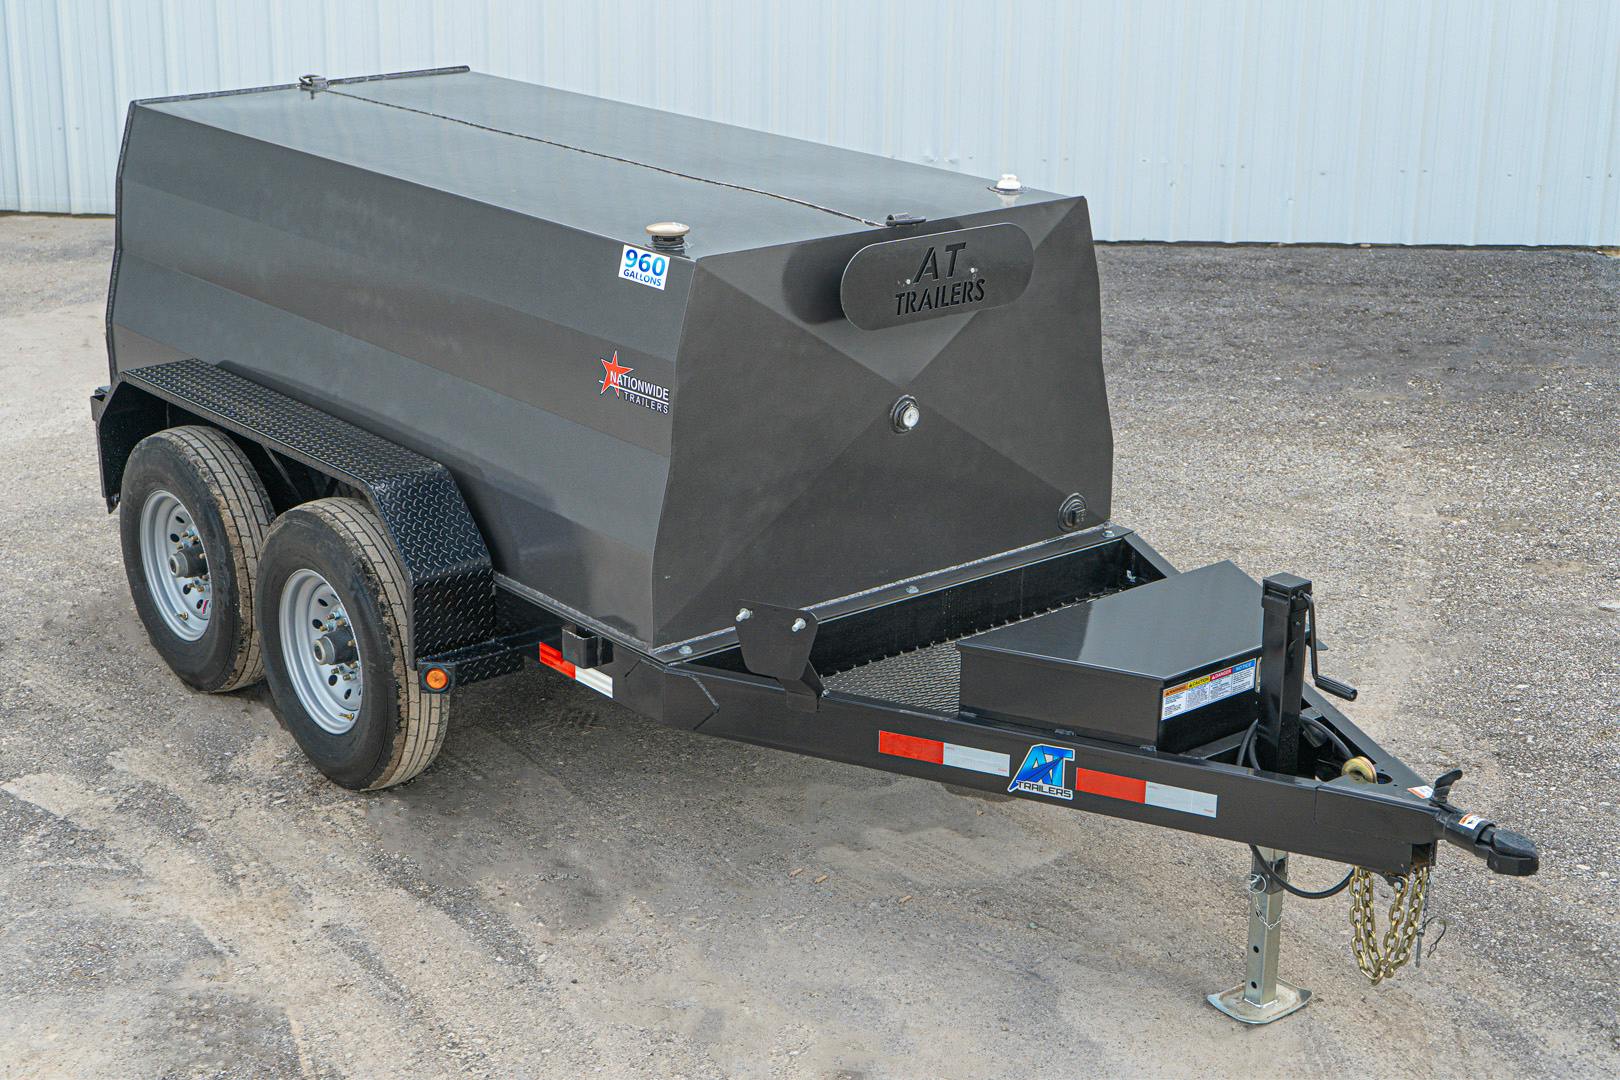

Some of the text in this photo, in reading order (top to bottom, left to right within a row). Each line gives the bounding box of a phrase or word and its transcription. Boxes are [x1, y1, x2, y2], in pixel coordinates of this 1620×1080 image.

[625, 249, 666, 277] 960
[913, 241, 967, 283] AT
[623, 269, 662, 287] GALLONS
[895, 278, 986, 316] TRAILERS
[610, 370, 669, 401] NATIONWIDE
[624, 391, 669, 414] TRAILERS
[1192, 677, 1210, 687] CAUTION
[1214, 668, 1232, 679] DANGER
[1018, 780, 1072, 798] TRAILERS
